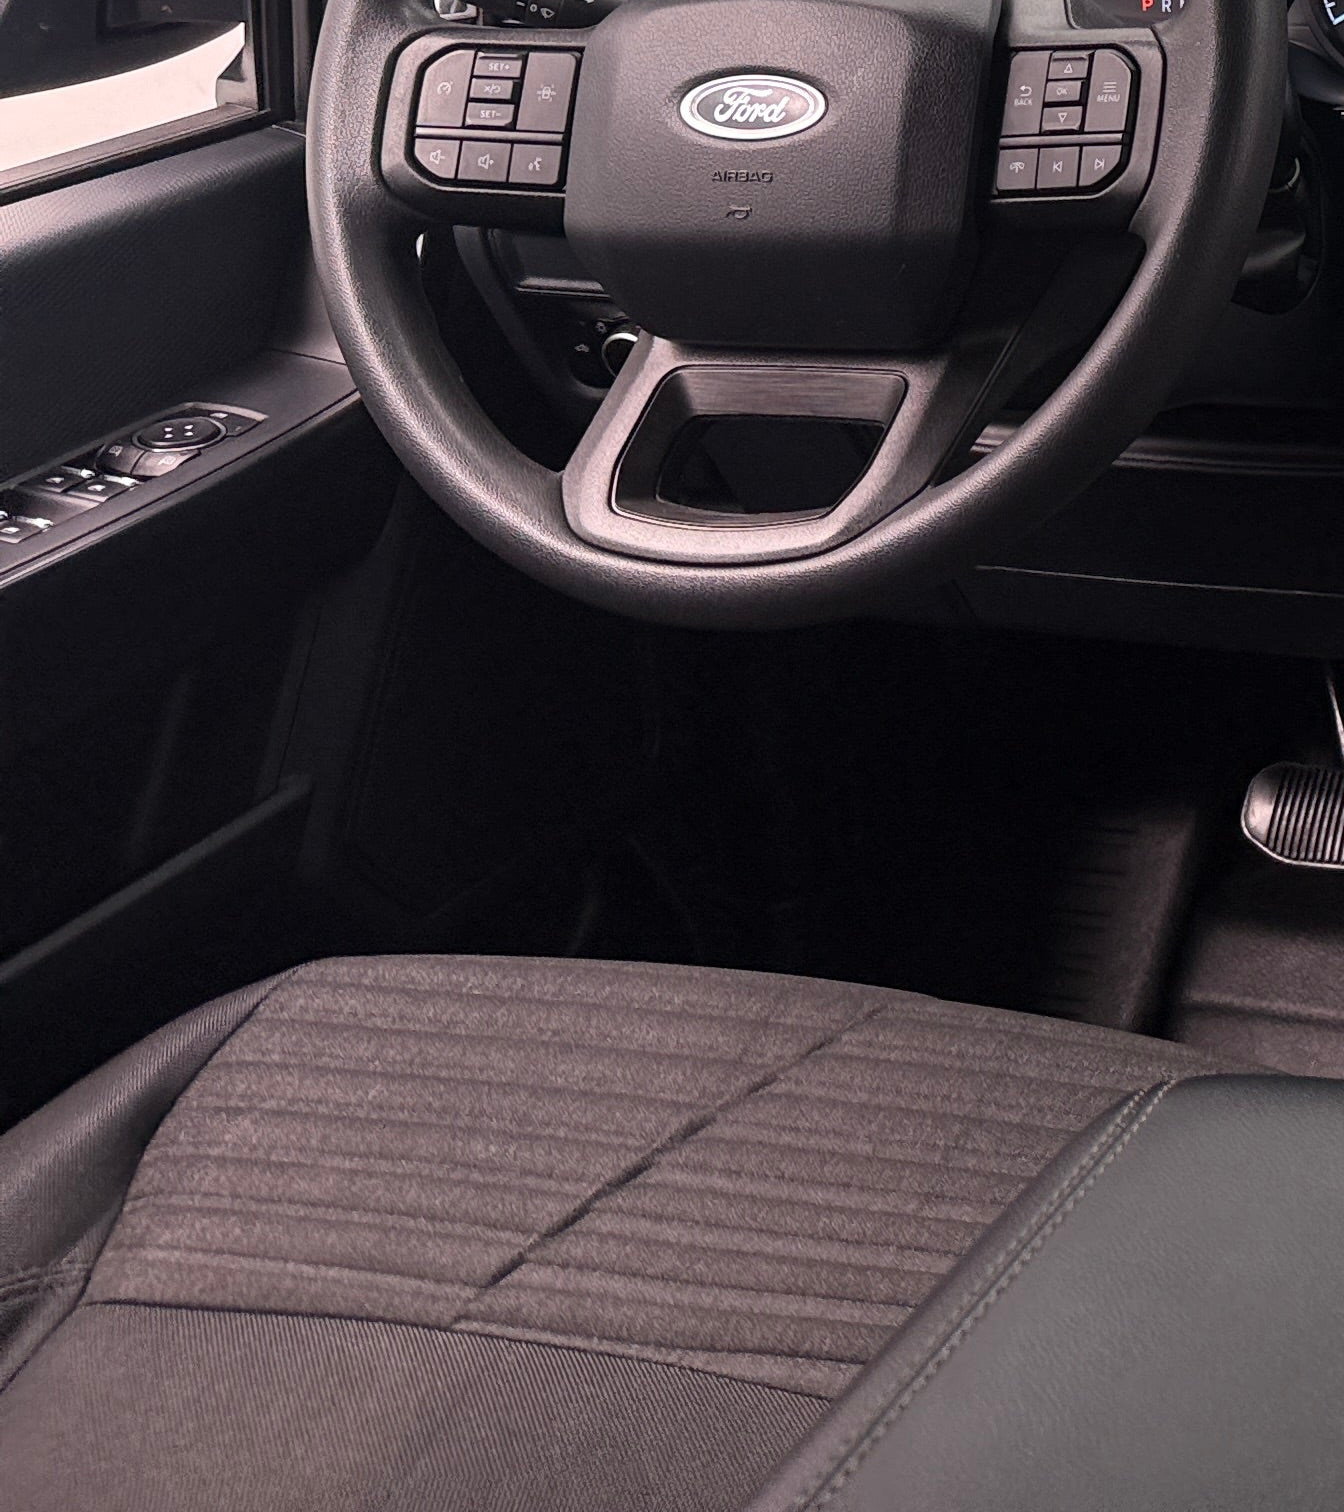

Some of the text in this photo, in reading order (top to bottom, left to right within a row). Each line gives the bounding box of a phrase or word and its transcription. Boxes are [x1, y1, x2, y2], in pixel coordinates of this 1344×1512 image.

[1056, 87, 1068, 96] OK
[1014, 98, 1033, 107] BACK
[1096, 93, 1121, 103] MENU
[712, 86, 787, 125] Ford
[711, 170, 774, 184] AIRBAG
